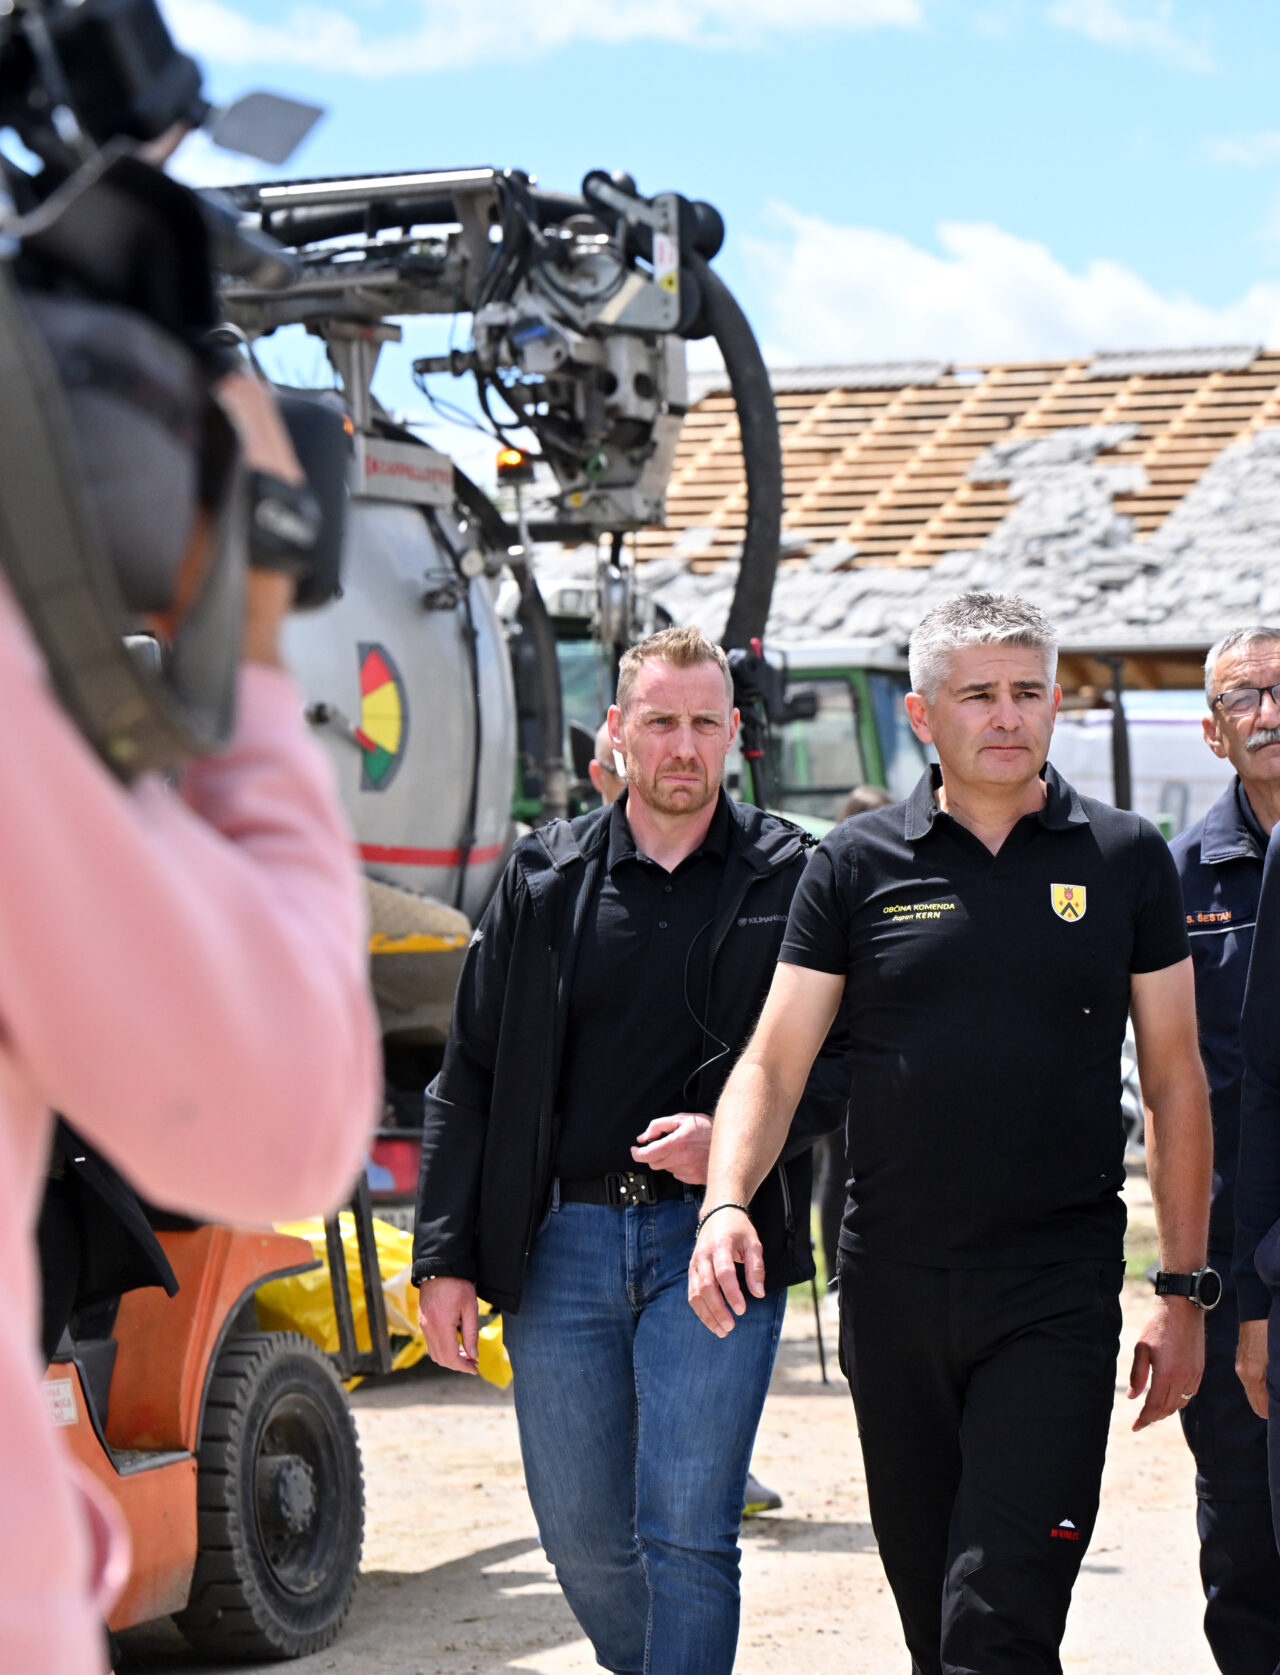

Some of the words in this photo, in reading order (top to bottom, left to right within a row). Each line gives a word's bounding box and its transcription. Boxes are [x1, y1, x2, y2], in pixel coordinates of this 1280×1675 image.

[883, 904, 911, 914] OBČINA
[913, 903, 955, 911] KOMENDA
[915, 911, 941, 919] KERN
[1186, 914, 1194, 924] S.
[1197, 911, 1232, 922] ŠESTAN
